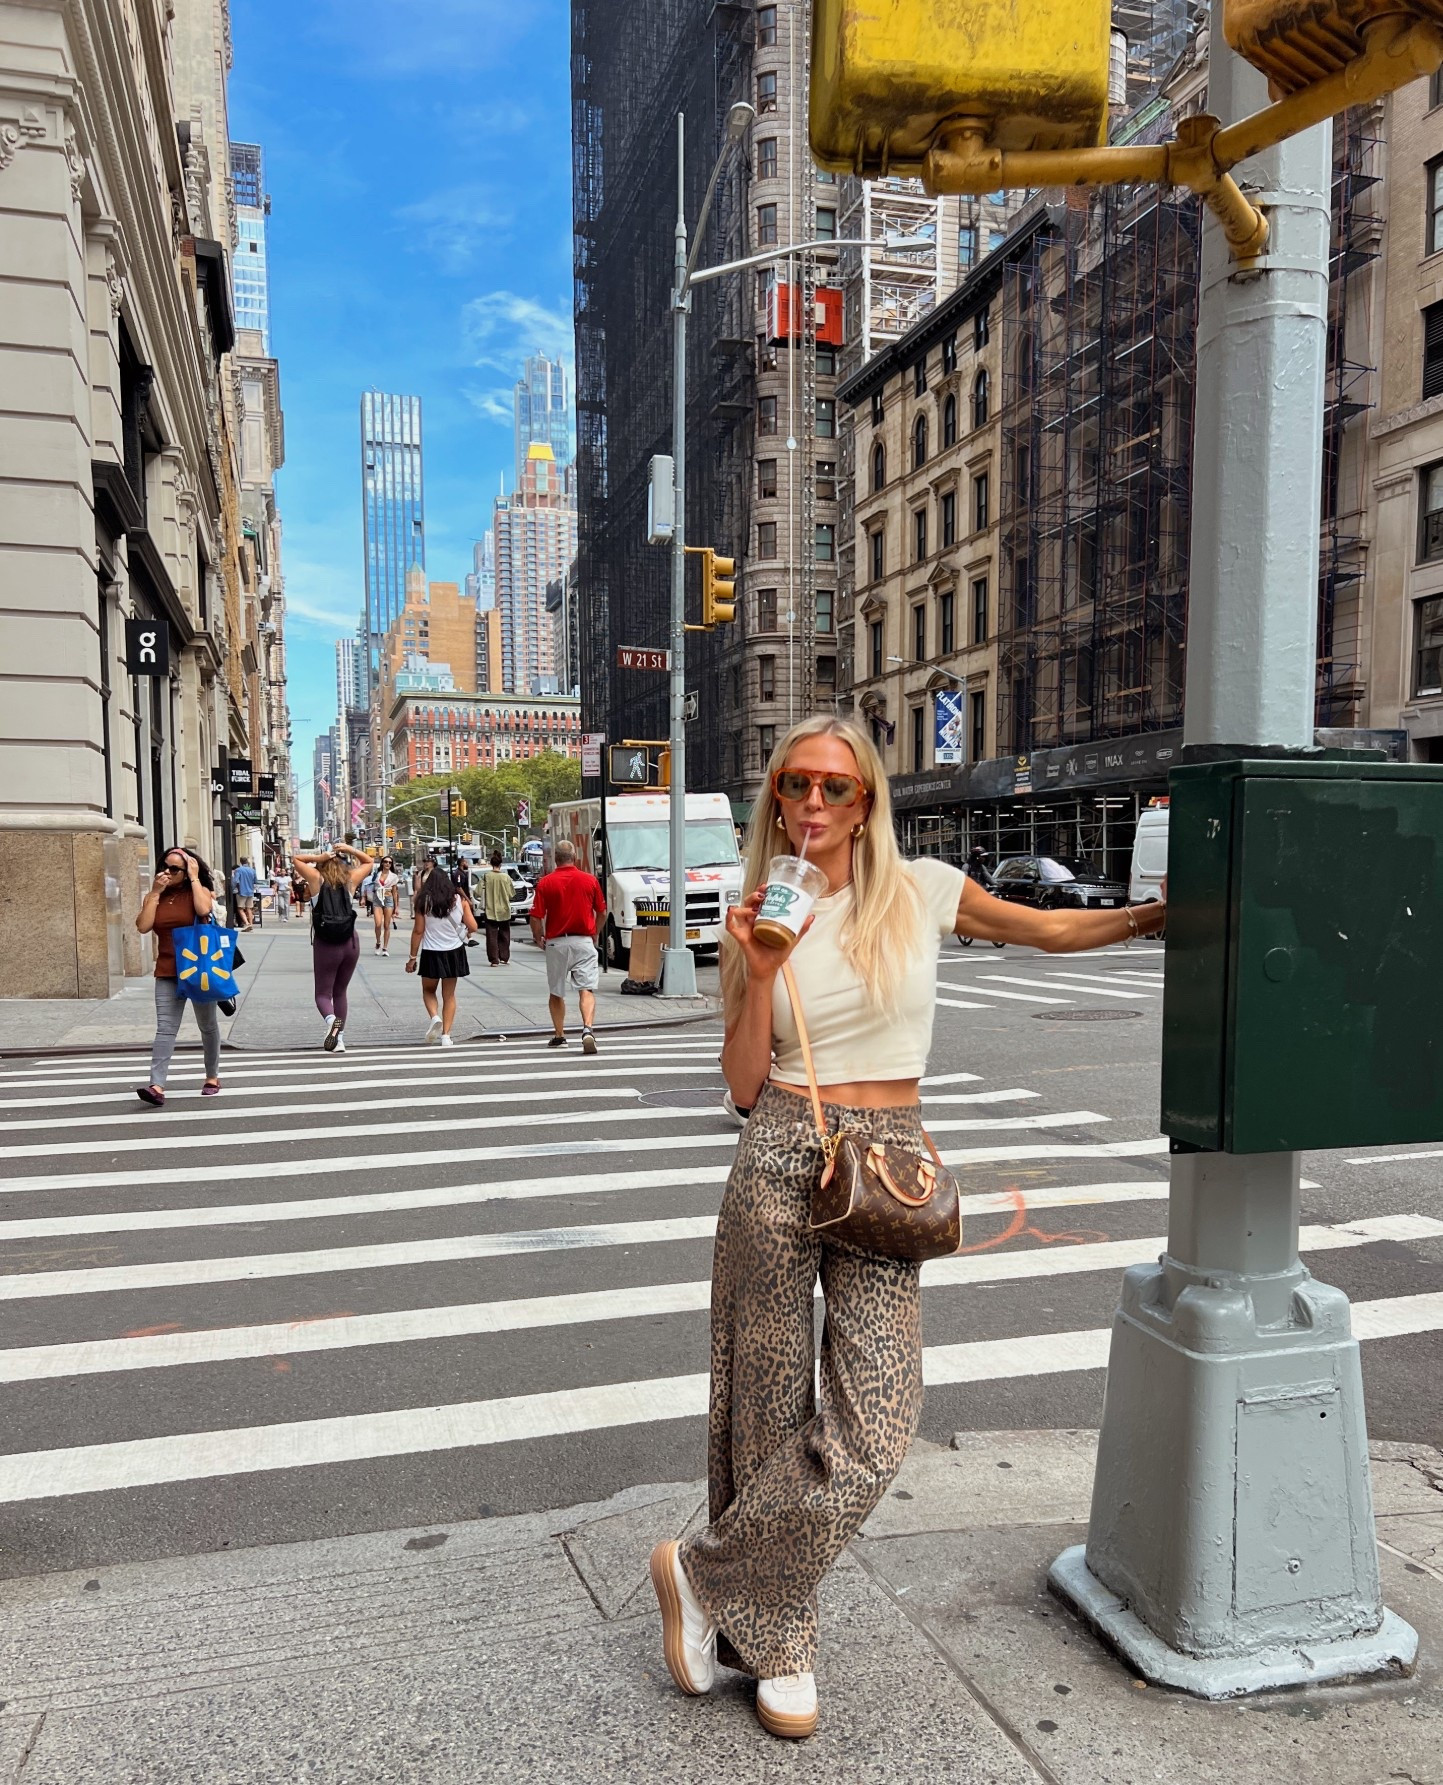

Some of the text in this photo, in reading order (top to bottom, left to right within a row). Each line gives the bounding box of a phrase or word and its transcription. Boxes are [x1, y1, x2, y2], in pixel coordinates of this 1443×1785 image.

[622, 652, 662, 668] W 21 St
[583, 735, 590, 744] 3
[1104, 755, 1123, 768] INAX
